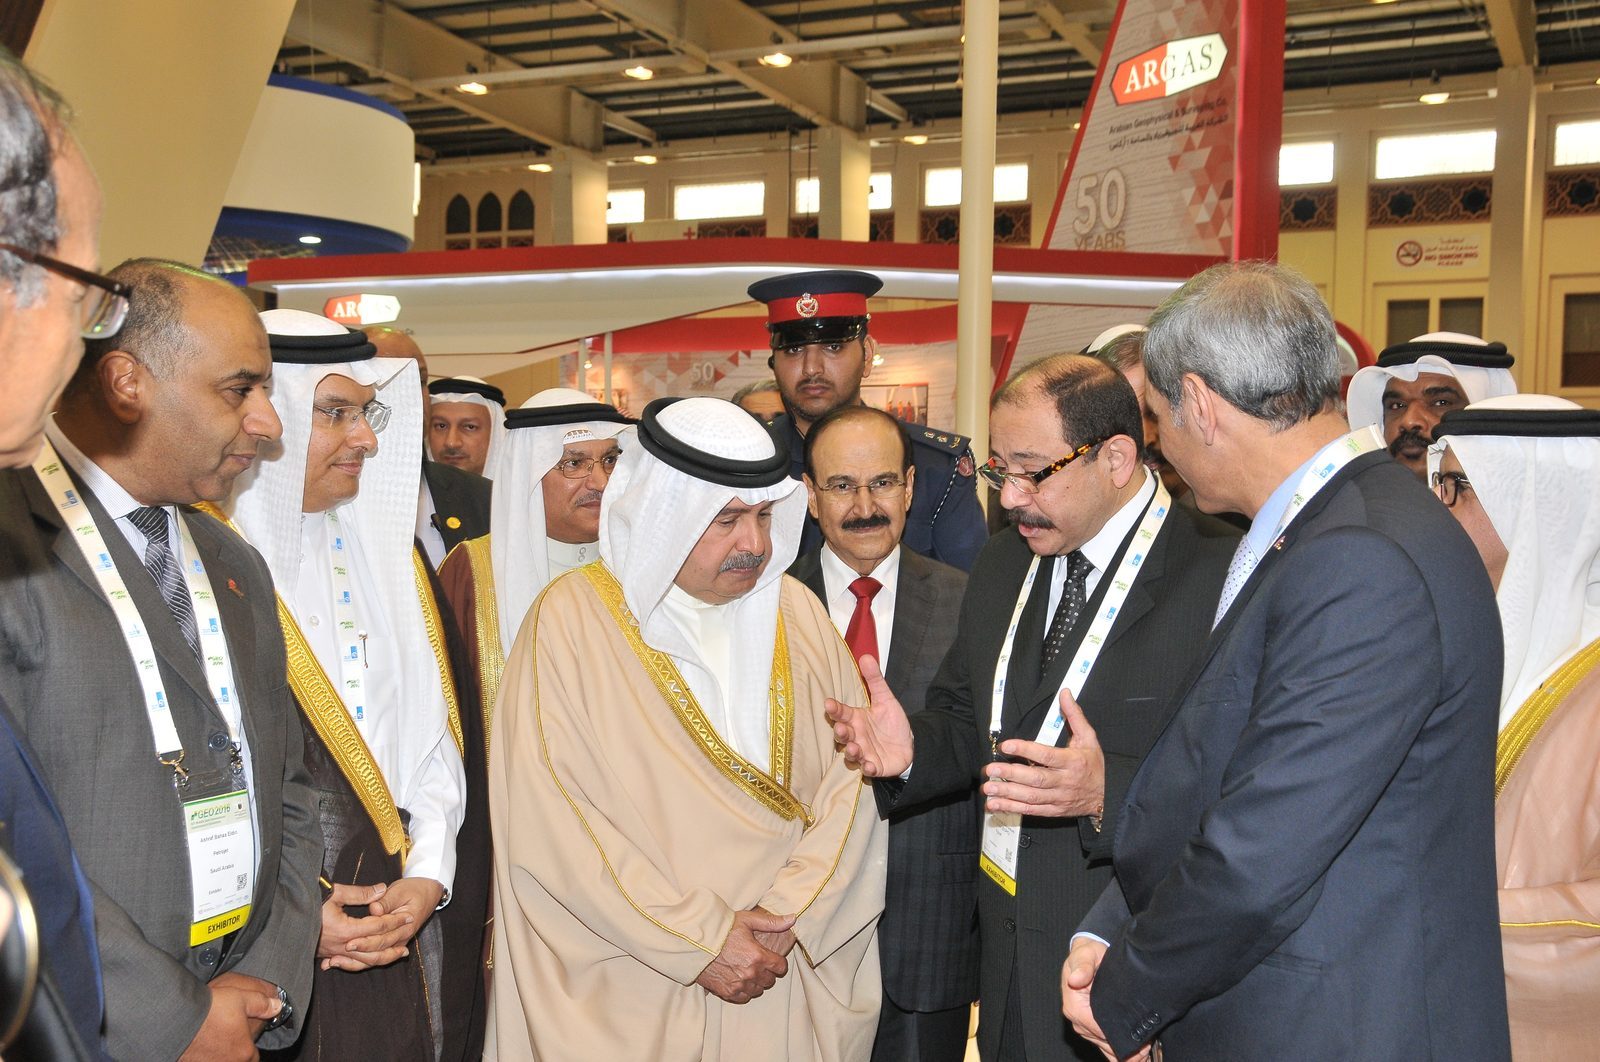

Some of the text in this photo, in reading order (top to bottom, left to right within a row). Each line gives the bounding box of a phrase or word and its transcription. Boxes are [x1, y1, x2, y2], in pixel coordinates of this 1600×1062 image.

[1124, 43, 1214, 95] ARGAS
[1073, 167, 1127, 235] 50
[1074, 230, 1126, 250] YEARS
[207, 914, 241, 934] EXHIBITOR
